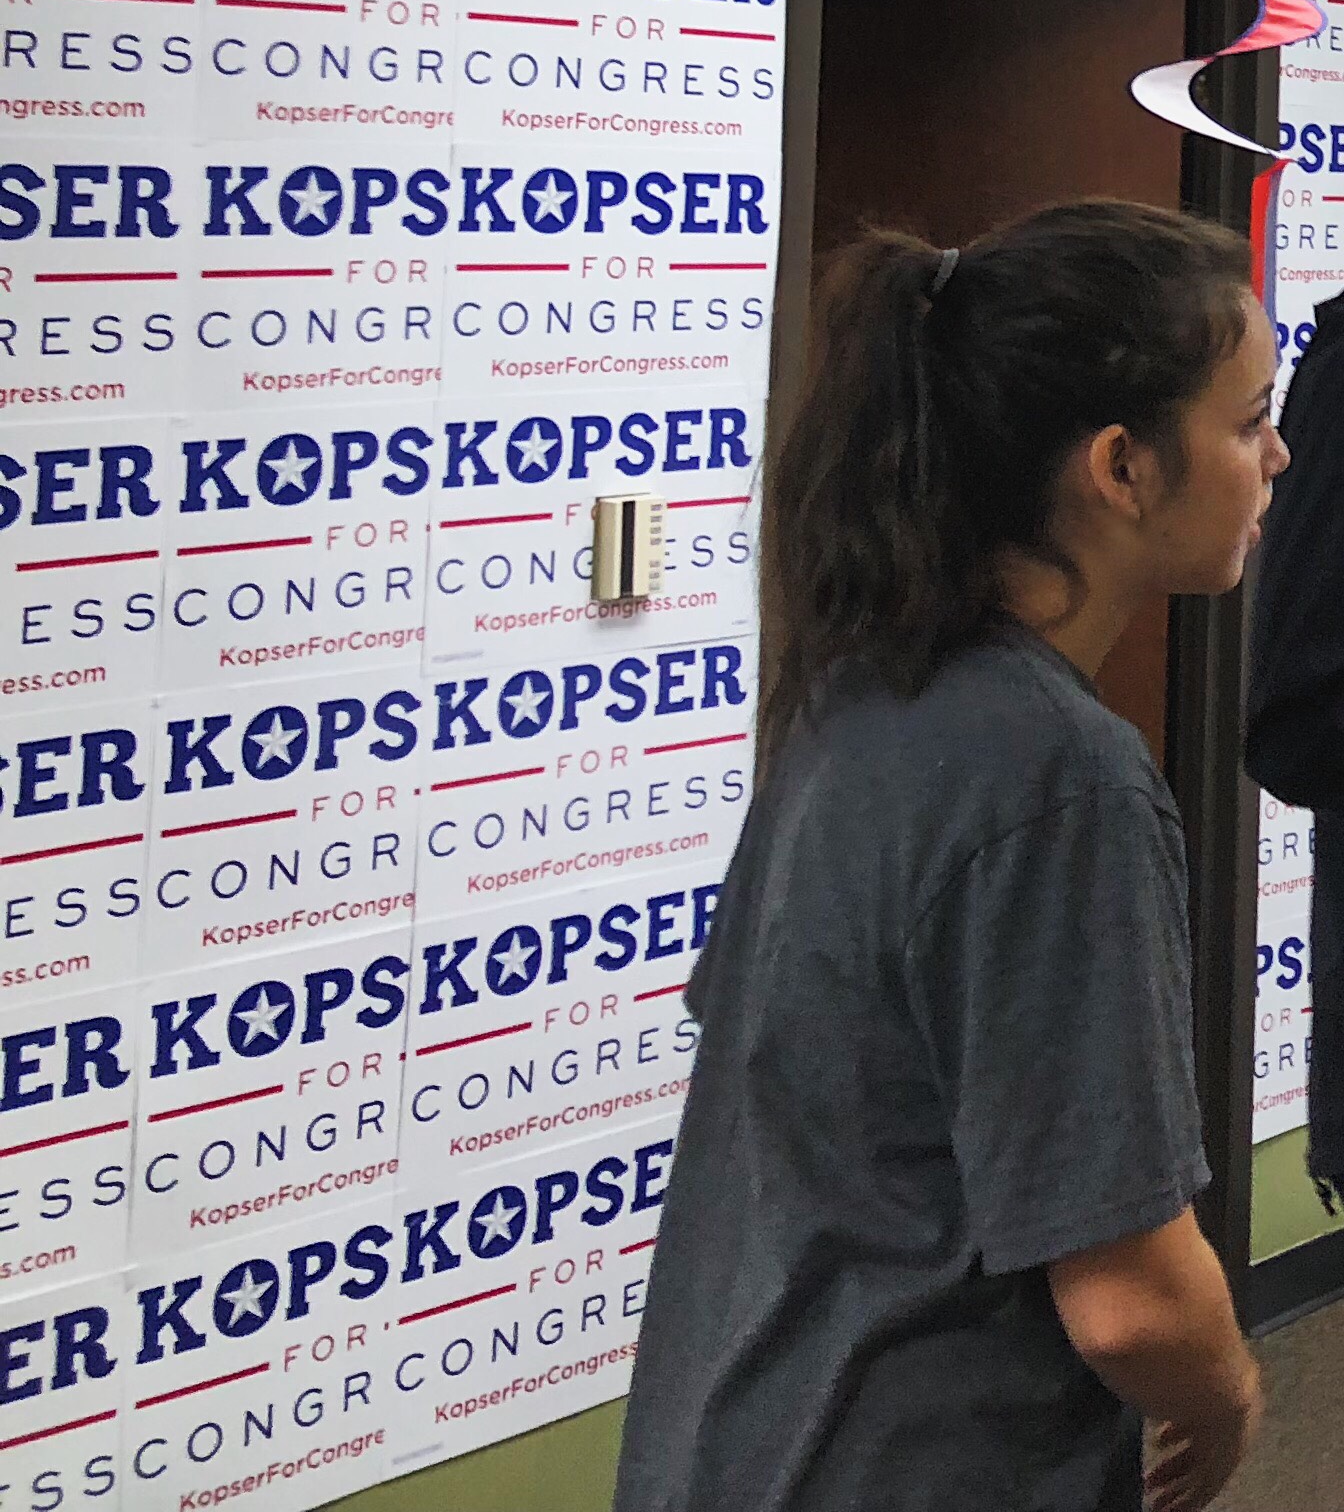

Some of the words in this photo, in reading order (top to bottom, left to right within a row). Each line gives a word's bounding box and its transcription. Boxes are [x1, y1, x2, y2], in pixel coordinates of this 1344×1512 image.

[359, 0, 440, 27] FOR
[592, 14, 667, 42] FOR
[465, 50, 775, 101] CONGRESS
[502, 108, 743, 138] KopserForCongress.com
[458, 167, 770, 236] KOPSER
[347, 259, 428, 284] FOR
[582, 256, 655, 280] FOR
[453, 298, 763, 337] CONGRESS
[491, 354, 730, 378] KopserForCongress.com
[442, 408, 753, 488] KOPSER
[326, 520, 408, 551] FOR
[474, 590, 717, 633] KopserForCongress.com
[432, 645, 747, 751] KOPSER
[557, 745, 628, 778] FOR
[312, 785, 396, 821] FOR
[428, 770, 744, 857] CONGRESS
[467, 831, 709, 894] KopserForCongress.com
[544, 994, 618, 1034] FOR
[298, 1053, 382, 1095] FOR
[530, 1249, 603, 1293] FOR
[283, 1324, 367, 1372] FOR
